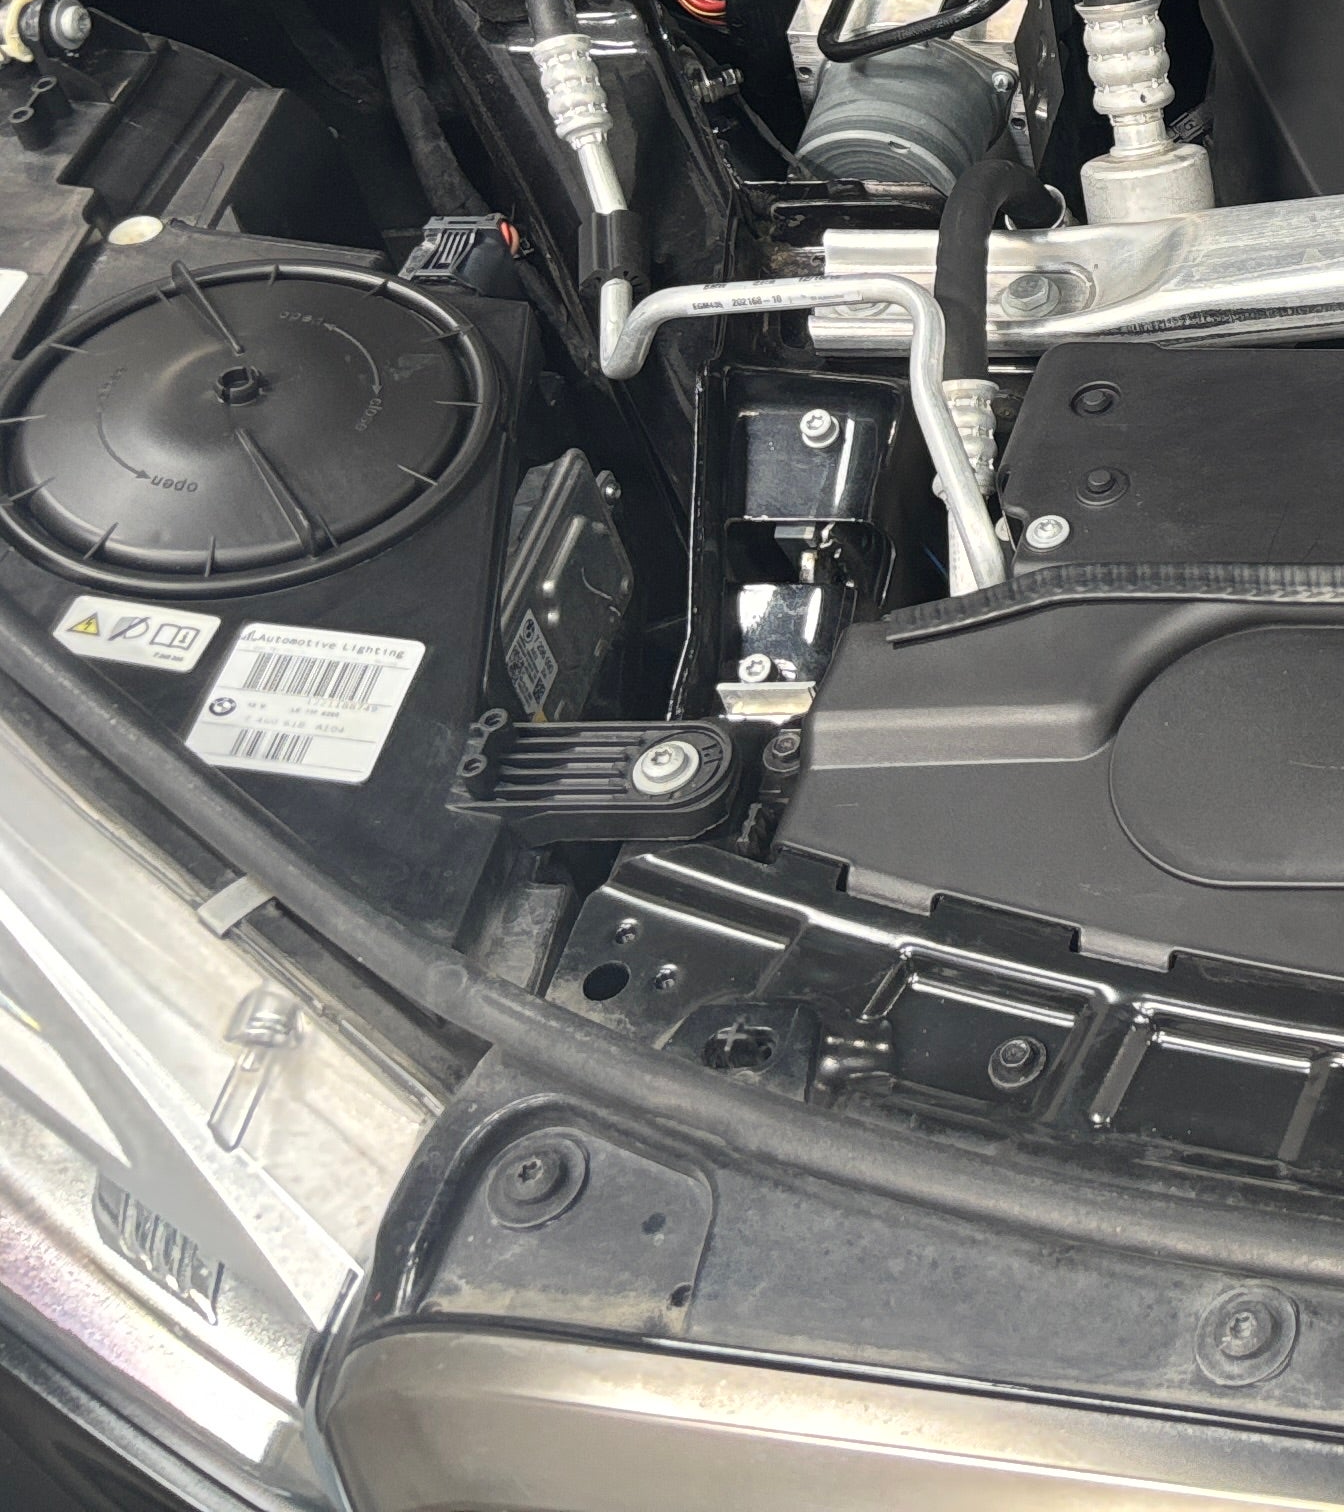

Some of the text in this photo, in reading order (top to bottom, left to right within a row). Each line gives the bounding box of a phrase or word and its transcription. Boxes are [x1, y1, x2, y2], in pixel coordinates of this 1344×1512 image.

[150, 473, 199, 494] open
[257, 632, 406, 660] Automotive Lighting
